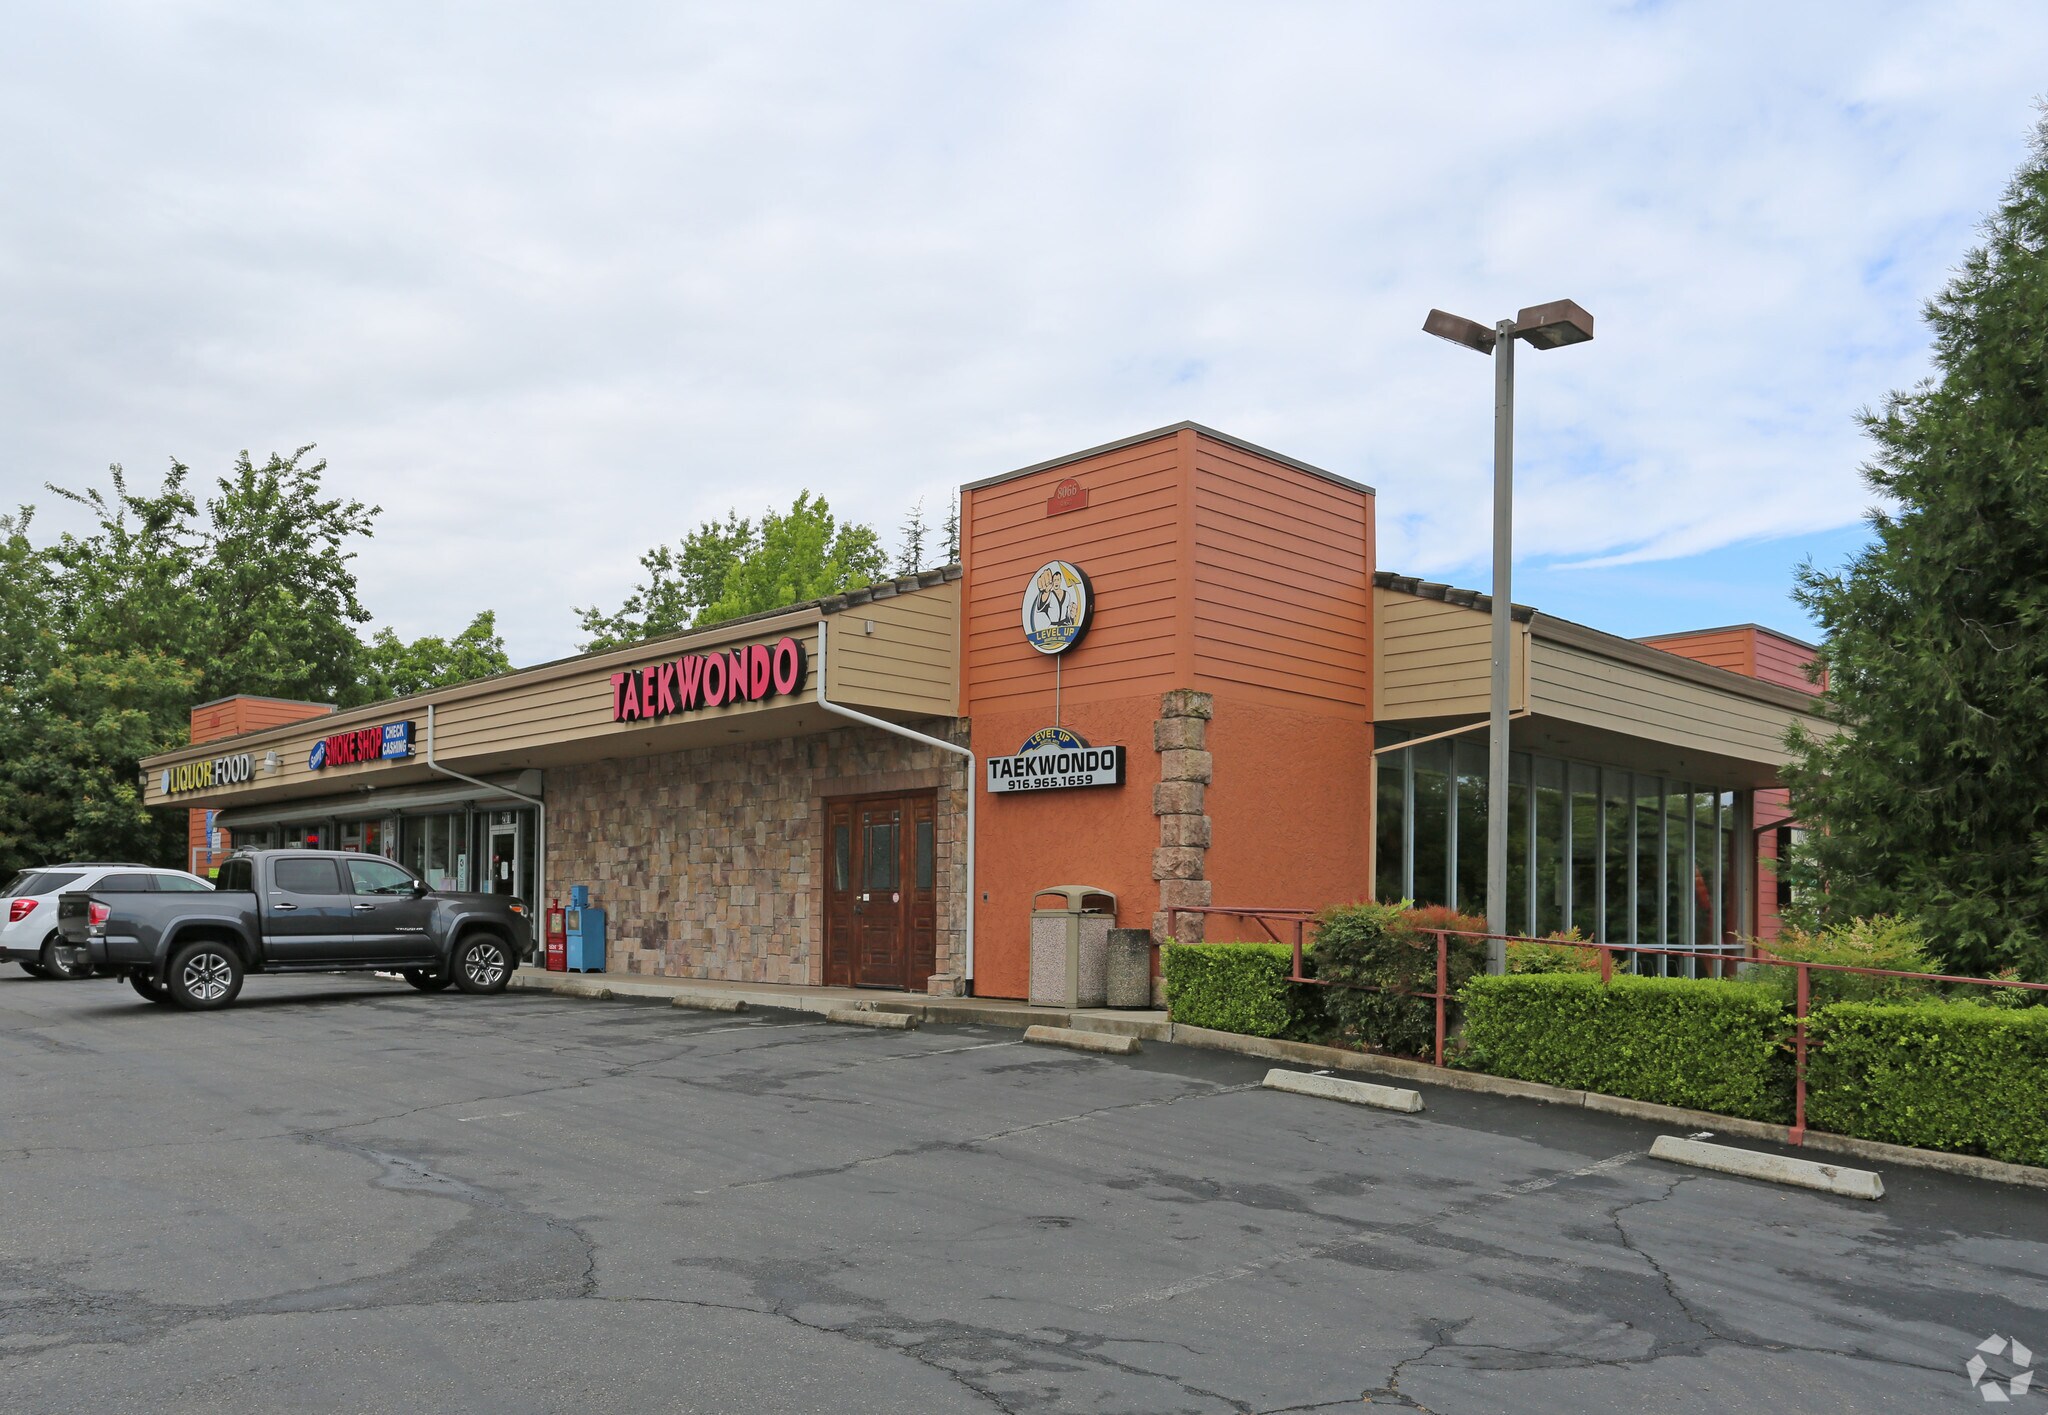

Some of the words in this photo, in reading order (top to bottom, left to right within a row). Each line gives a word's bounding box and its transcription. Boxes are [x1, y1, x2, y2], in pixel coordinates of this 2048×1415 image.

[1057, 483, 1078, 500] 8066
[1036, 627, 1061, 640] LEVEL
[1064, 627, 1075, 636] UP
[610, 637, 799, 722] TAEKWONDO
[385, 723, 404, 739] CHECK
[1030, 730, 1056, 745] LEVEL
[1058, 731, 1070, 743] UP
[326, 731, 355, 766] SMOKE
[358, 726, 382, 761] SHOP
[382, 739, 407, 755] CASHING
[989, 750, 1115, 779] TAEKWONDO
[170, 760, 212, 793] LIQUOR
[215, 753, 250, 787] FOOD
[1008, 774, 1093, 790] 916.965.1659
